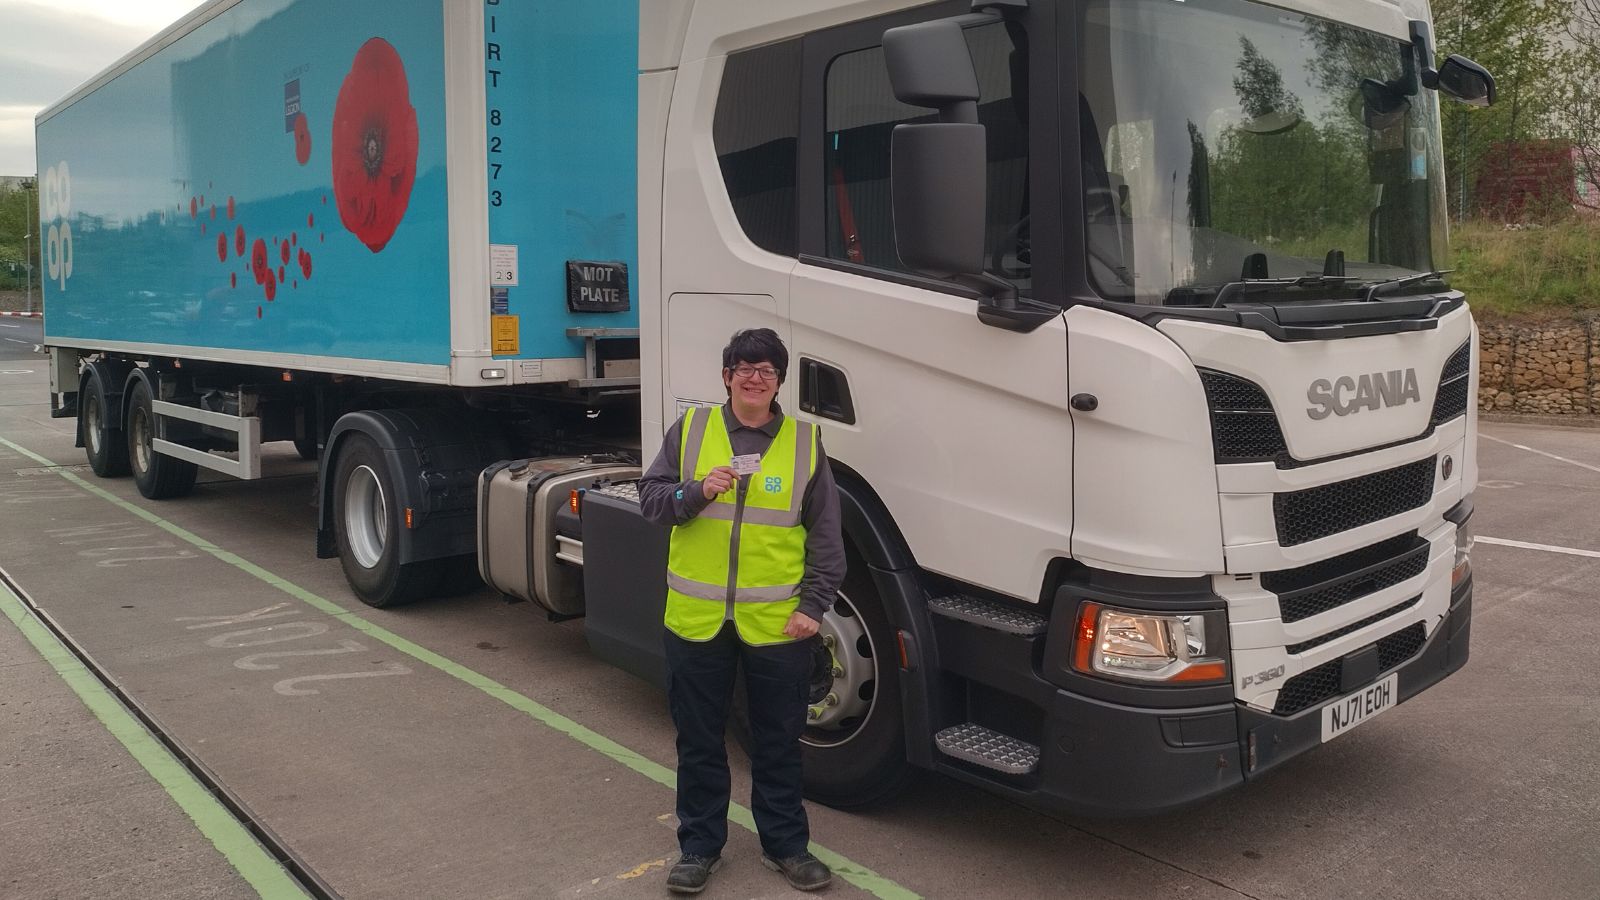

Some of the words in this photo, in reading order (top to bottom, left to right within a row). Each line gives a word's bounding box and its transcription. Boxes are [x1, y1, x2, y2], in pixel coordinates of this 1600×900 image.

[490, 109, 502, 207] 8273
[580, 286, 620, 302] PLATE
[584, 266, 613, 281] MOT
[1307, 368, 1420, 420] SCANIA
[1331, 695, 1363, 733] NJ71
[1365, 680, 1391, 714] EOH
